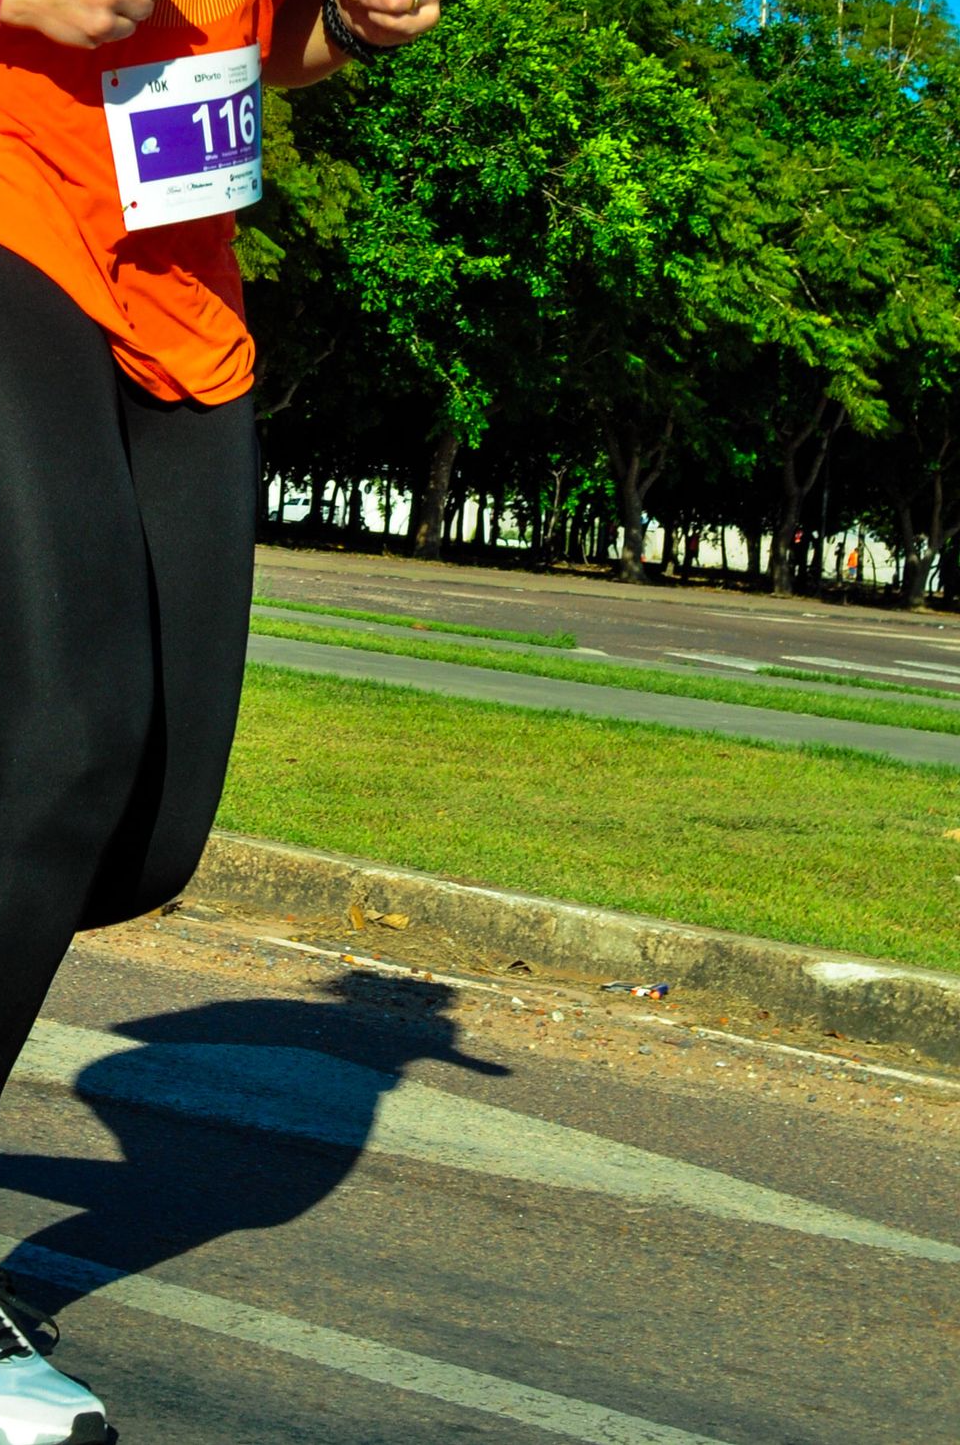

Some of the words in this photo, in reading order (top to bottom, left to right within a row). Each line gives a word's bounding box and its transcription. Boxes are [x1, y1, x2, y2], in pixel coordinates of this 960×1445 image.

[201, 72, 222, 83] Porto
[148, 80, 169, 94] 10K
[192, 95, 256, 154] 116
